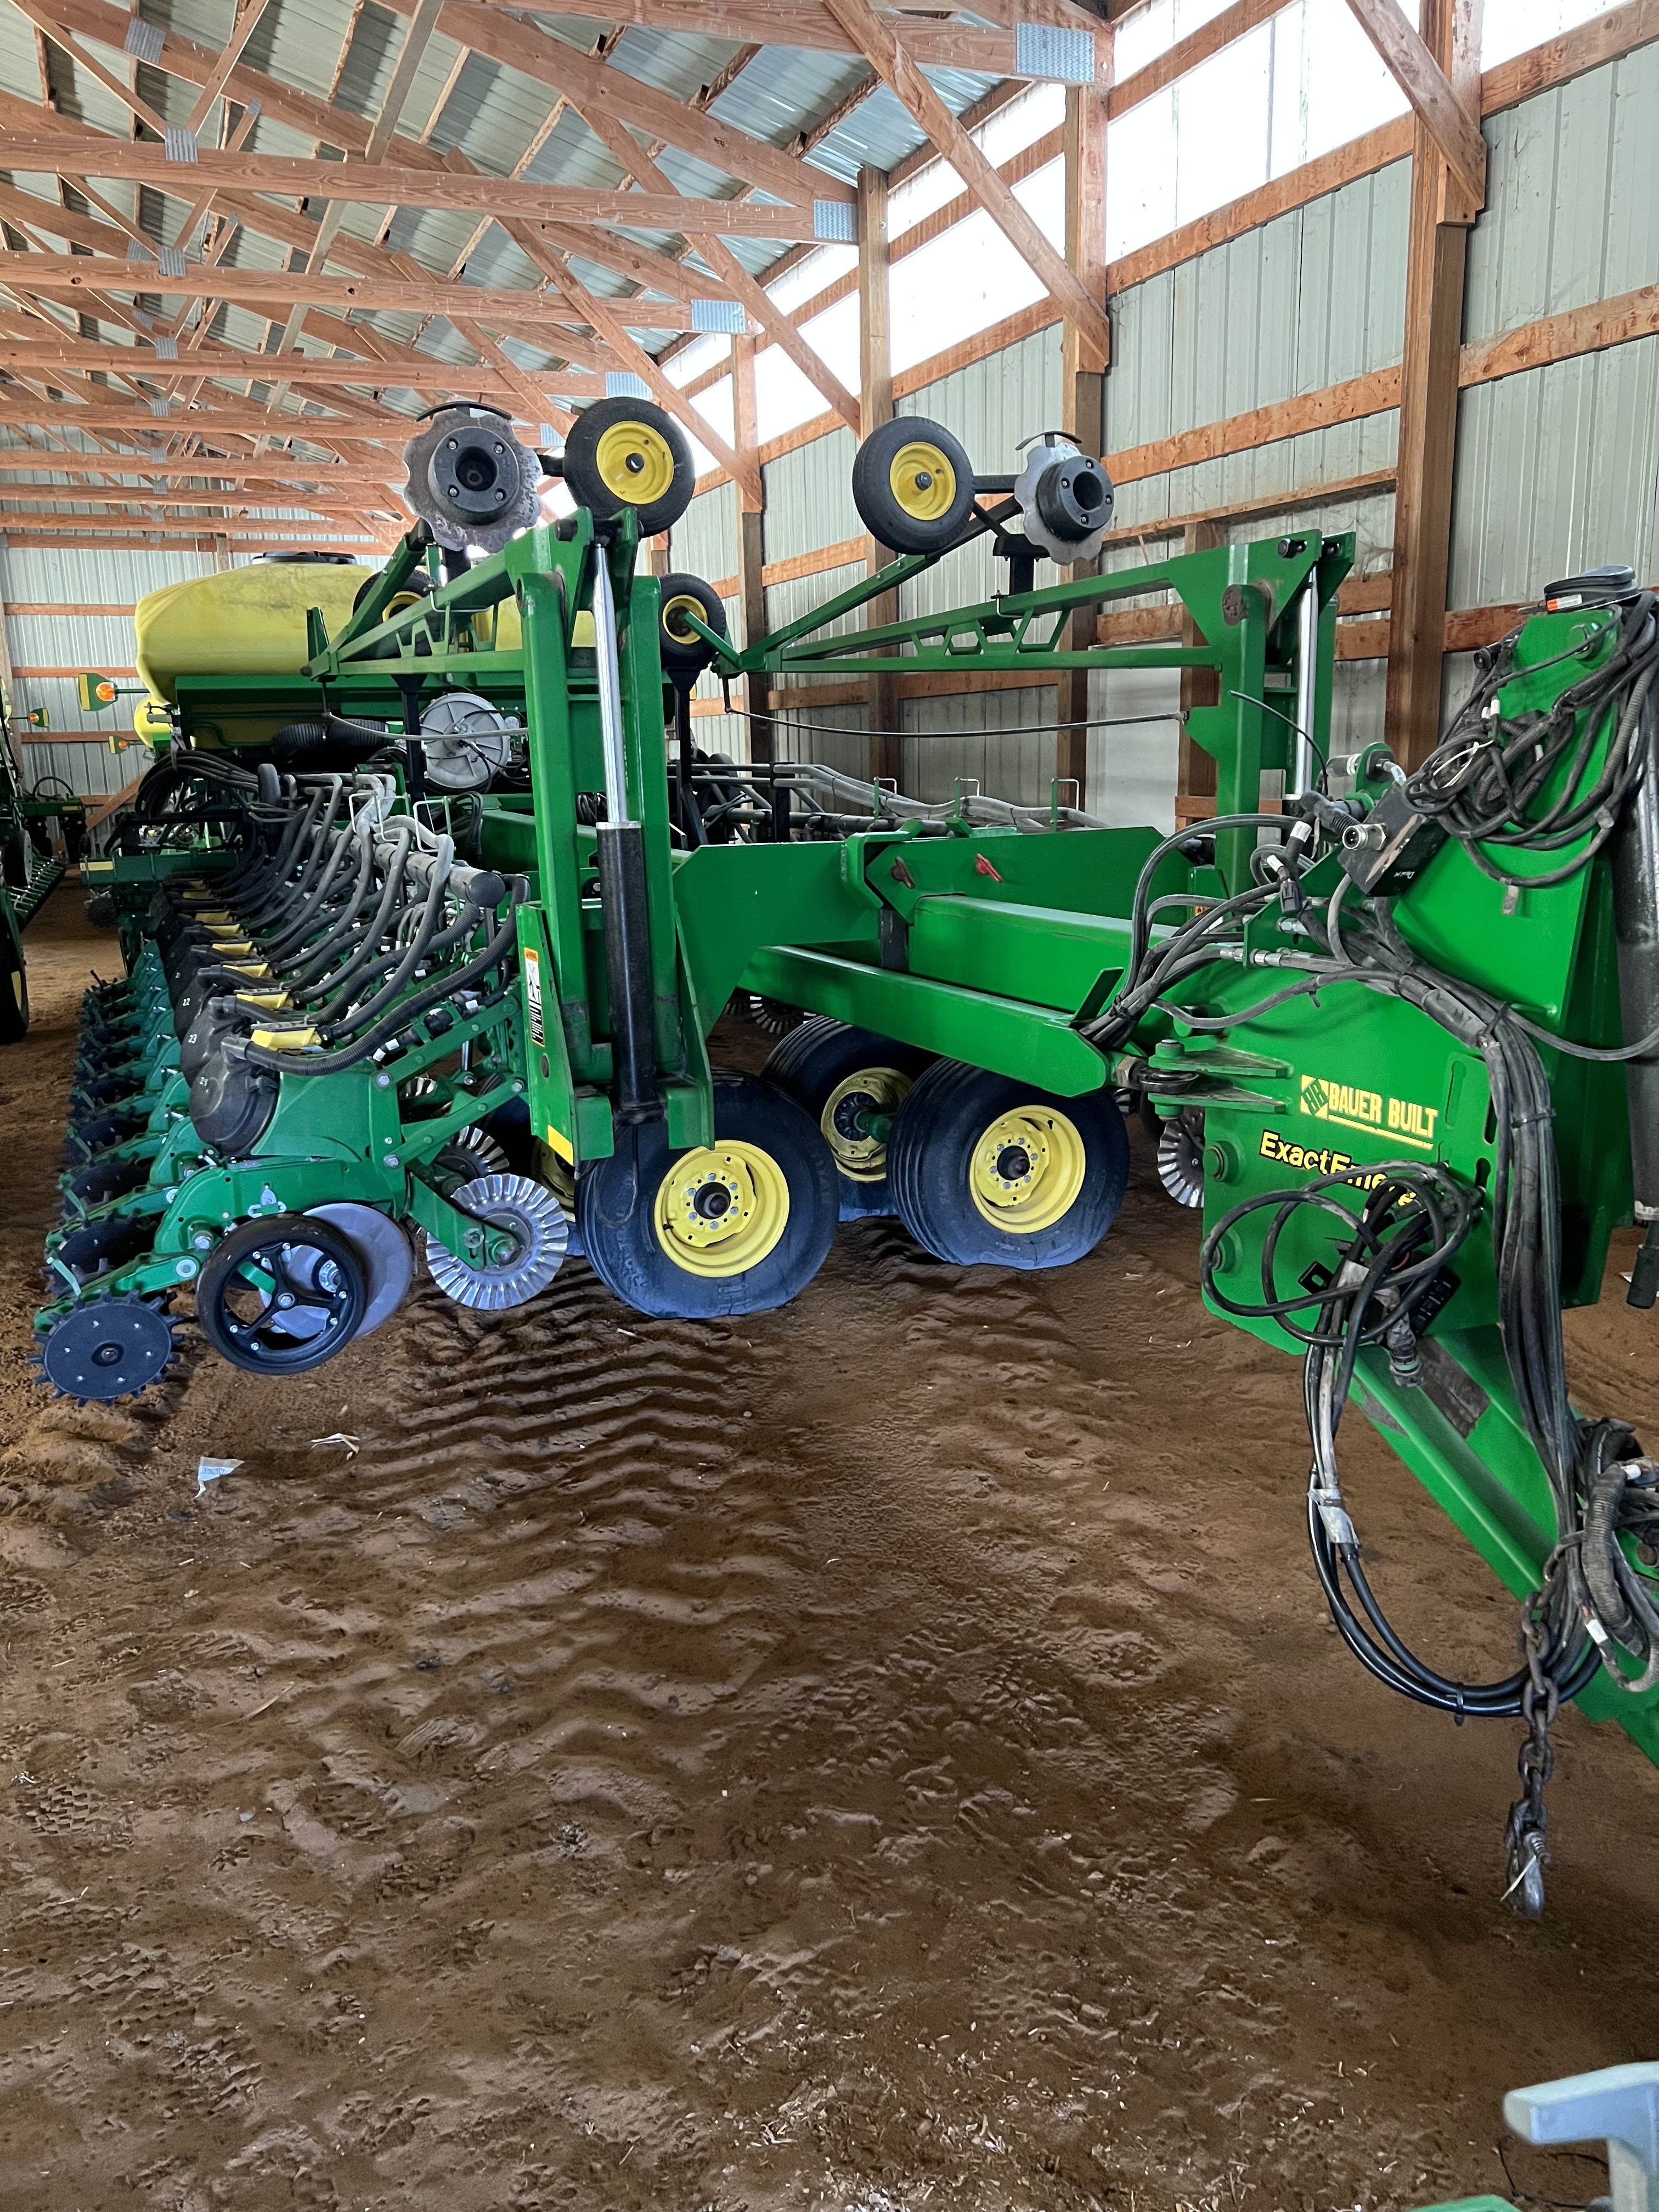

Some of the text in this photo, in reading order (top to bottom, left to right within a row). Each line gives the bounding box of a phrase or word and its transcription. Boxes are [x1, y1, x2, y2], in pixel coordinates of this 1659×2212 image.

[183, 998, 190, 1006] 22
[188, 1034, 198, 1043] 23
[1328, 1082, 1438, 1139] BAUER BUILT
